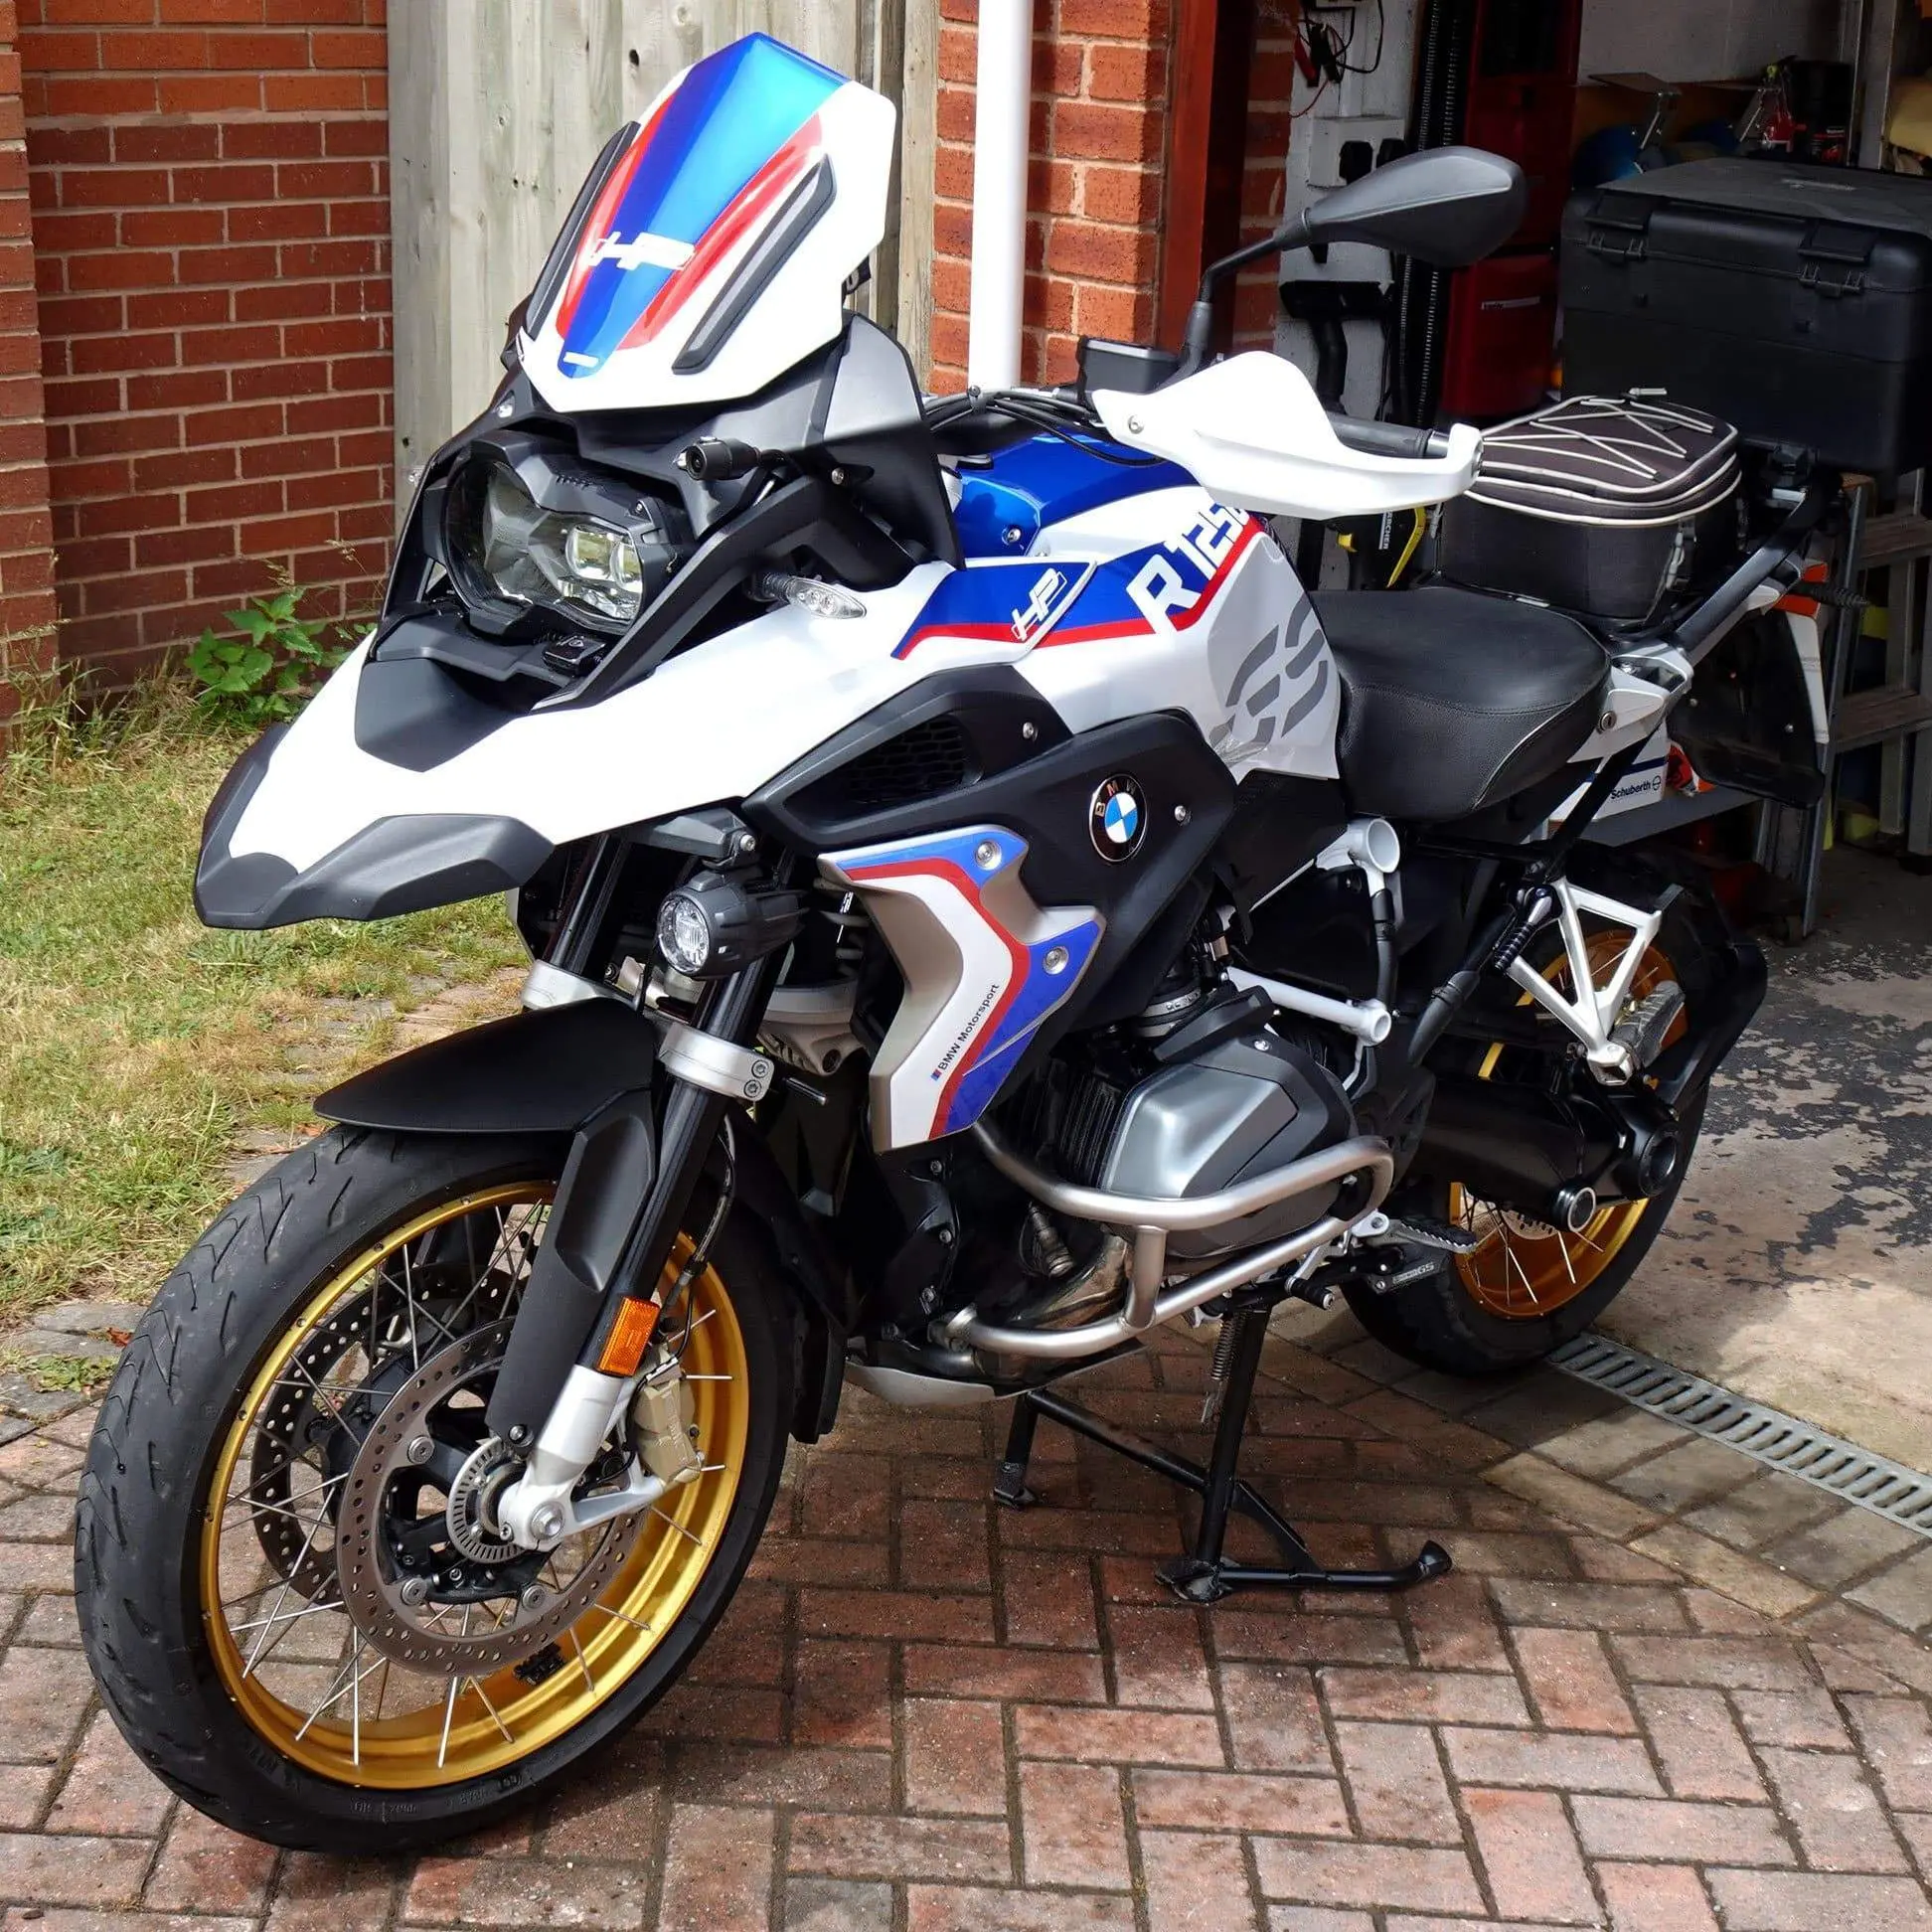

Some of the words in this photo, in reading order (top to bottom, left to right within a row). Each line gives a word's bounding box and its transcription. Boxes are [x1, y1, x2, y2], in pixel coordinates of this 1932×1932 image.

[1011, 567, 1068, 641] HP
[1094, 779, 1138, 817] BMW
[1610, 779, 1652, 799] Schuberth
[938, 1043, 961, 1070] BMW
[957, 984, 1000, 1043] Motorsport
